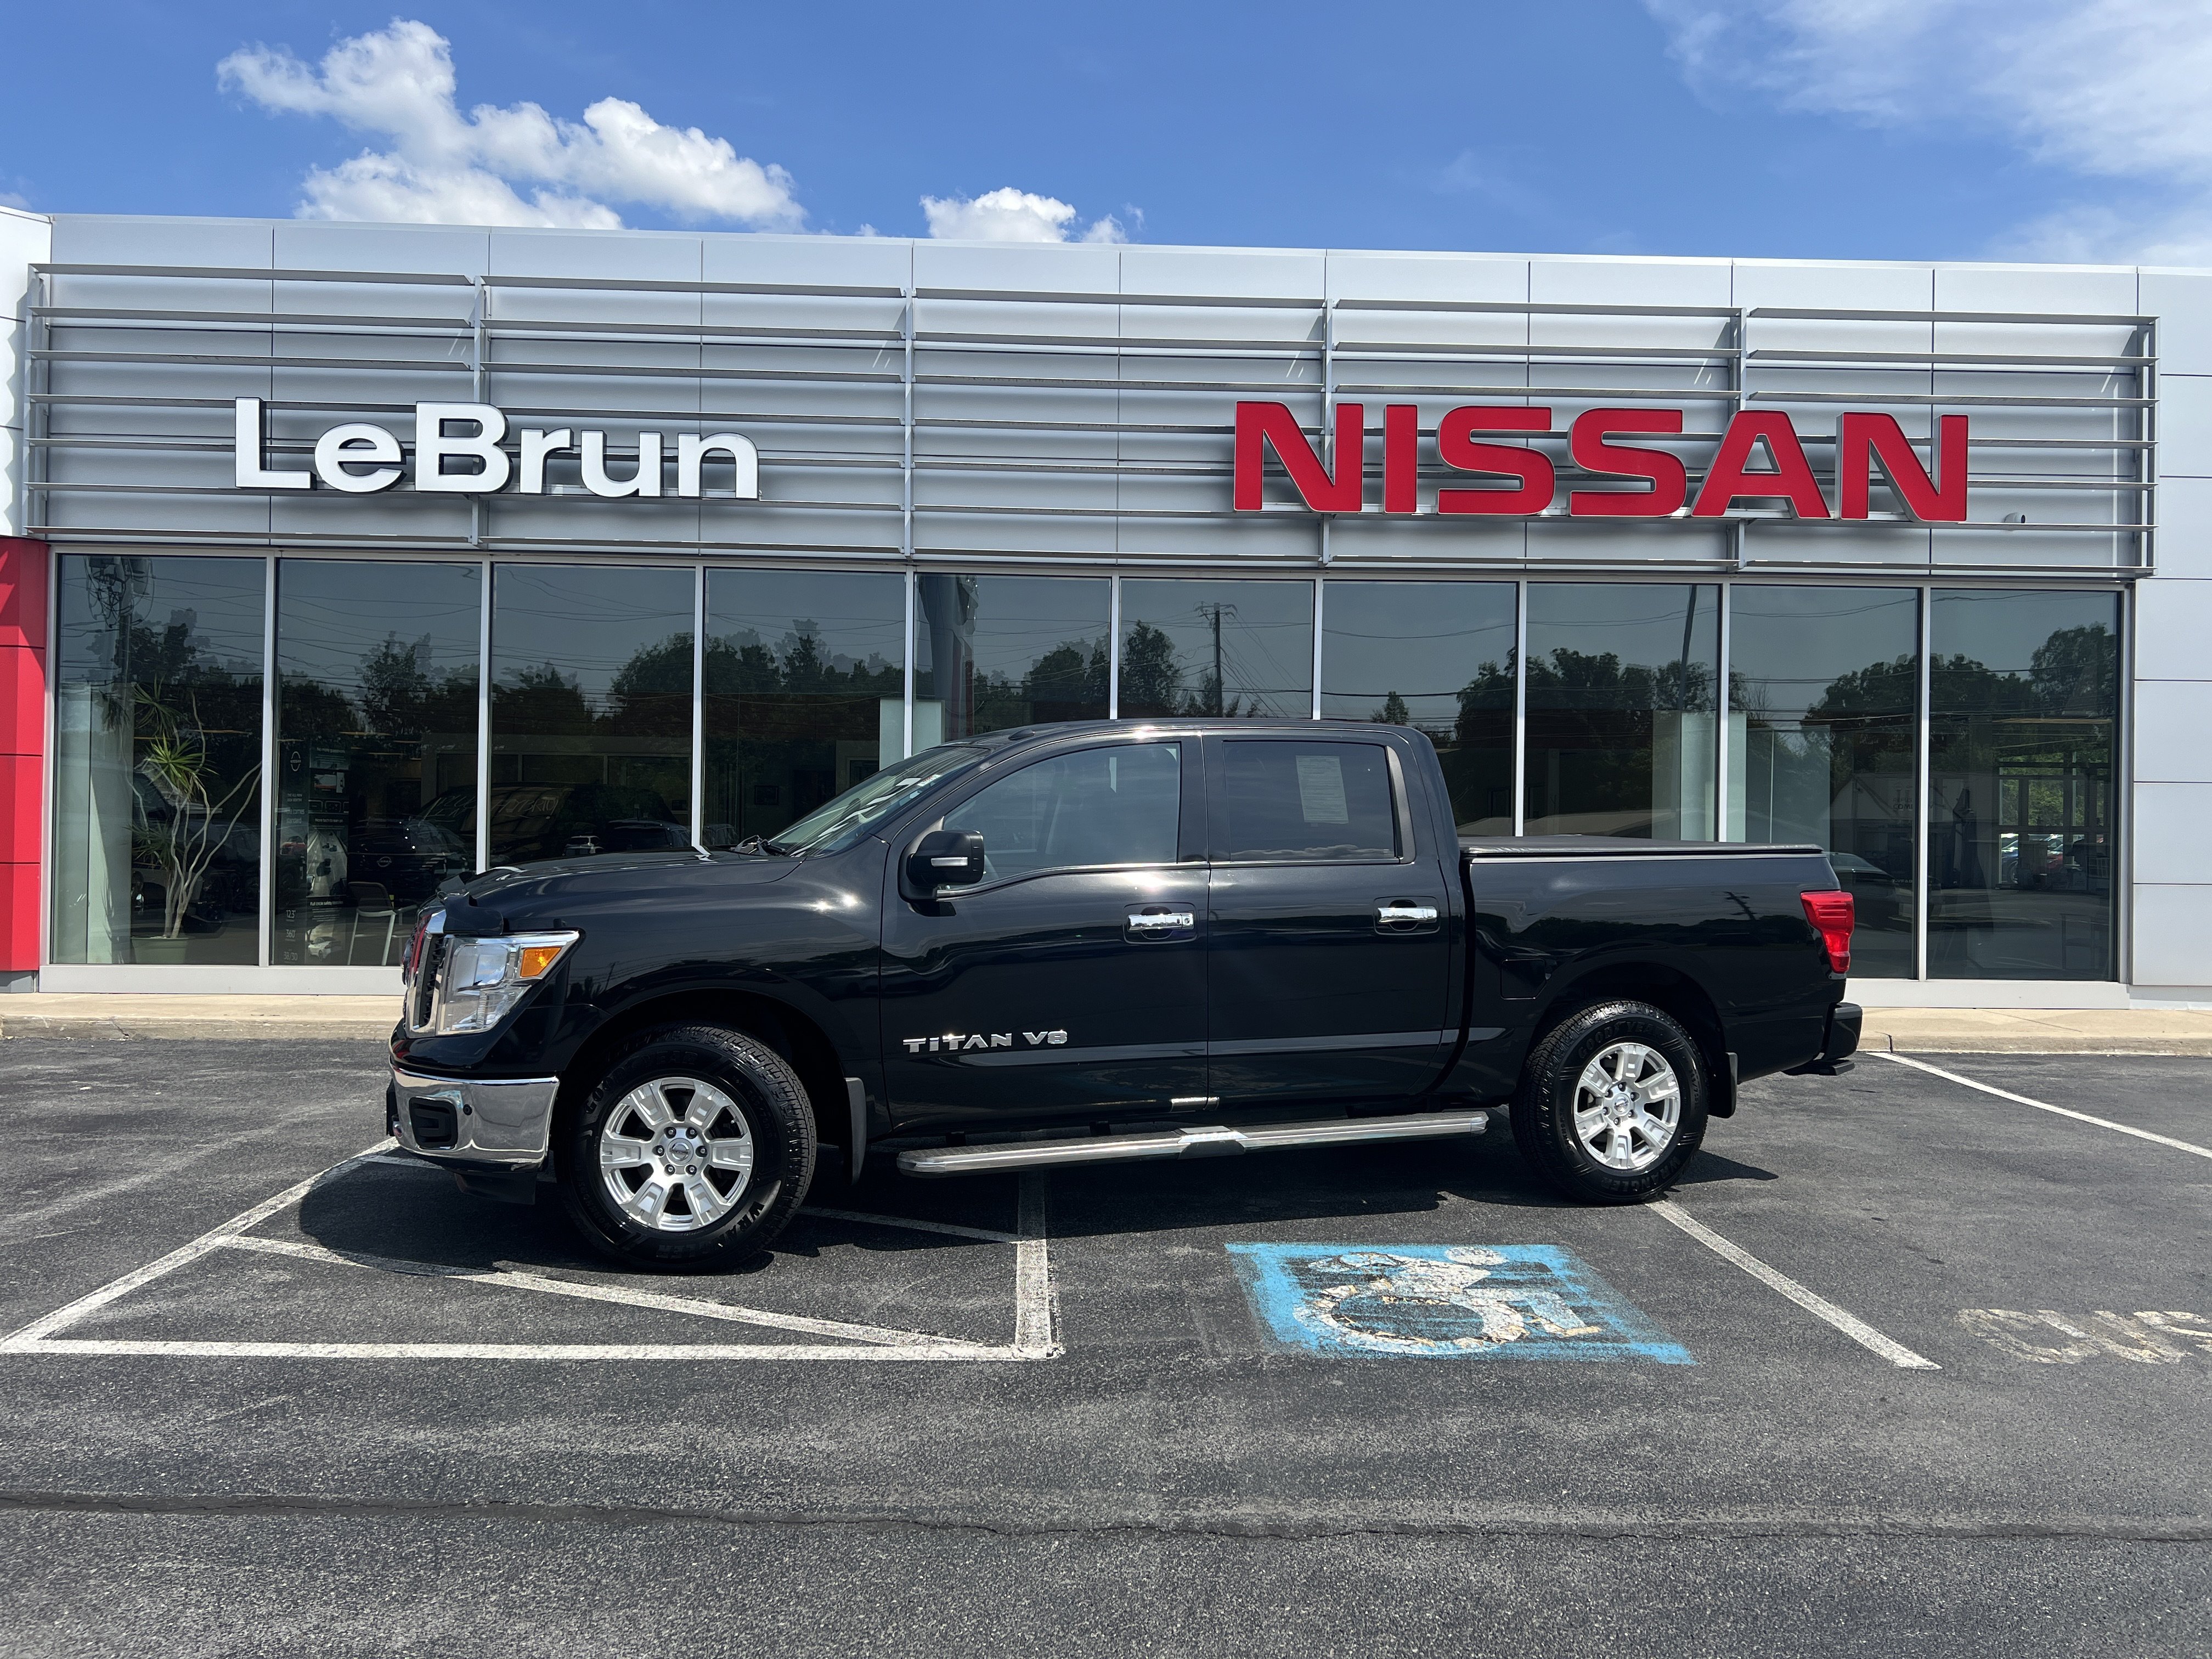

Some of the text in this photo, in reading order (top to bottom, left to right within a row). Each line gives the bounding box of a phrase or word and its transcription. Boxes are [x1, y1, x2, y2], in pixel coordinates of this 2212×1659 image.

[235, 397, 759, 500] LeBrun
[1233, 400, 1968, 522] NISSAN
[902, 1030, 1068, 1053] TITAN V8
